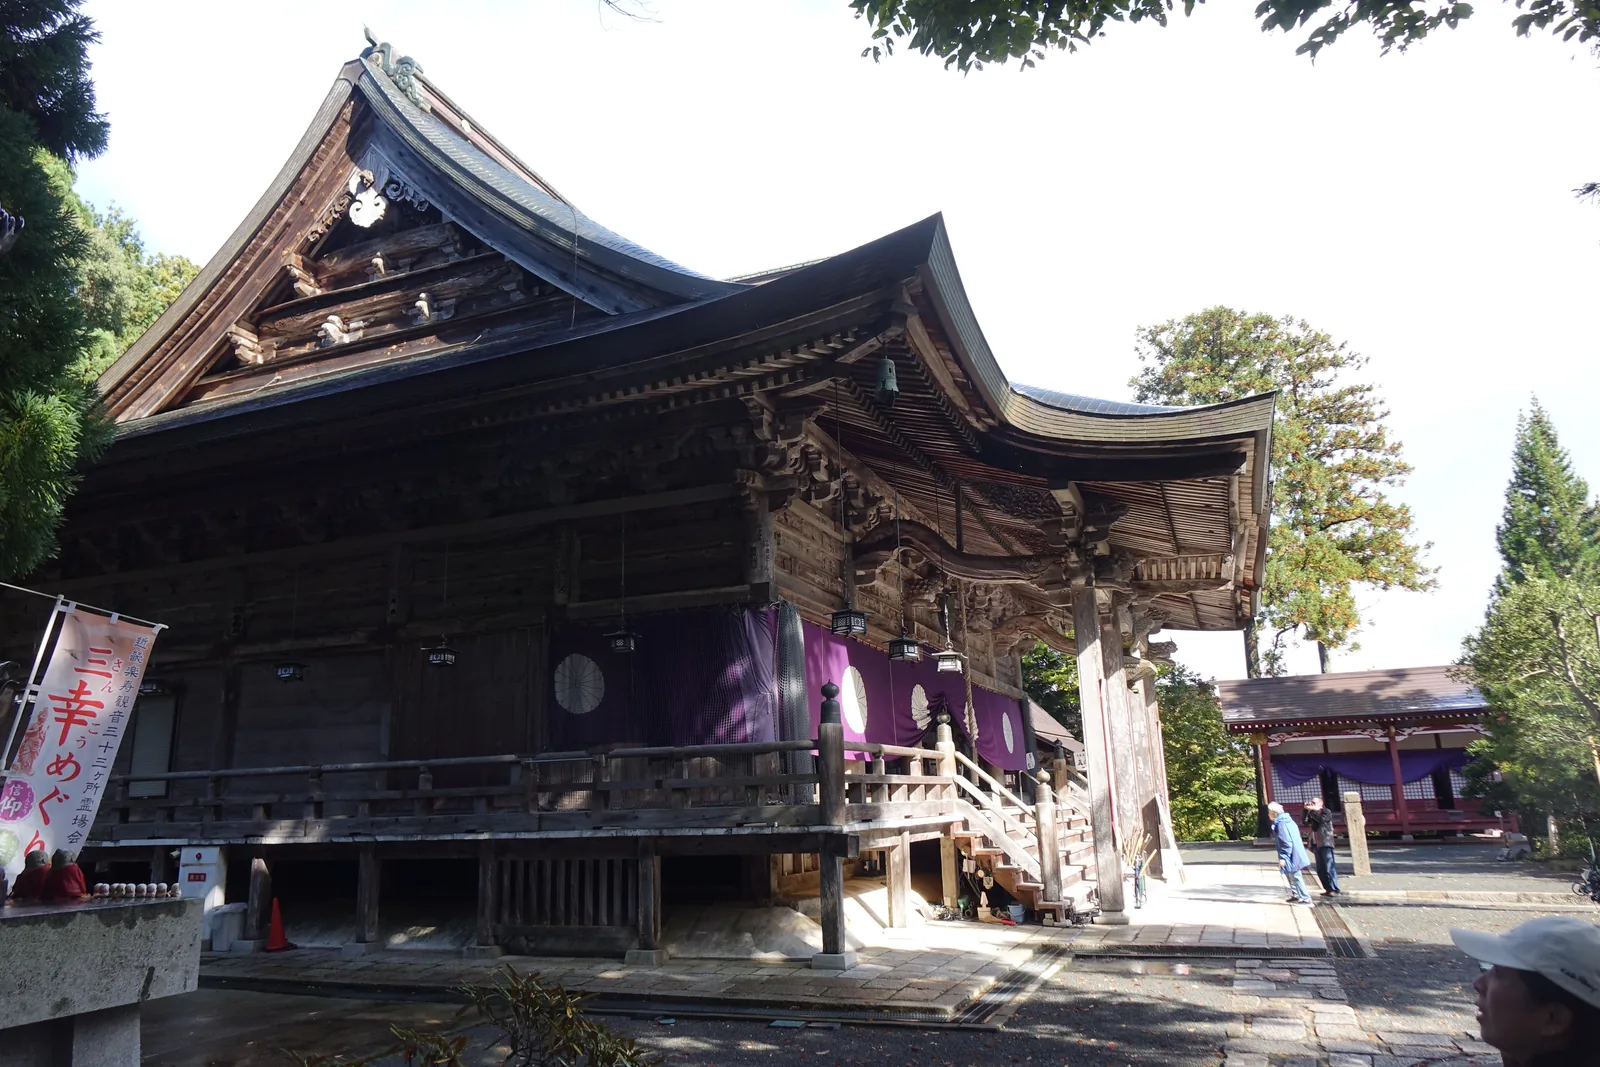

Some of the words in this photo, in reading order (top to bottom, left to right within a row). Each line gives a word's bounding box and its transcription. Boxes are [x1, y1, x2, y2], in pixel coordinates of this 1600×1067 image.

[67, 636, 149, 844] 近畿楽寿観音三十三ヶ所霊場会
[1, 784, 23, 817] 信仰
